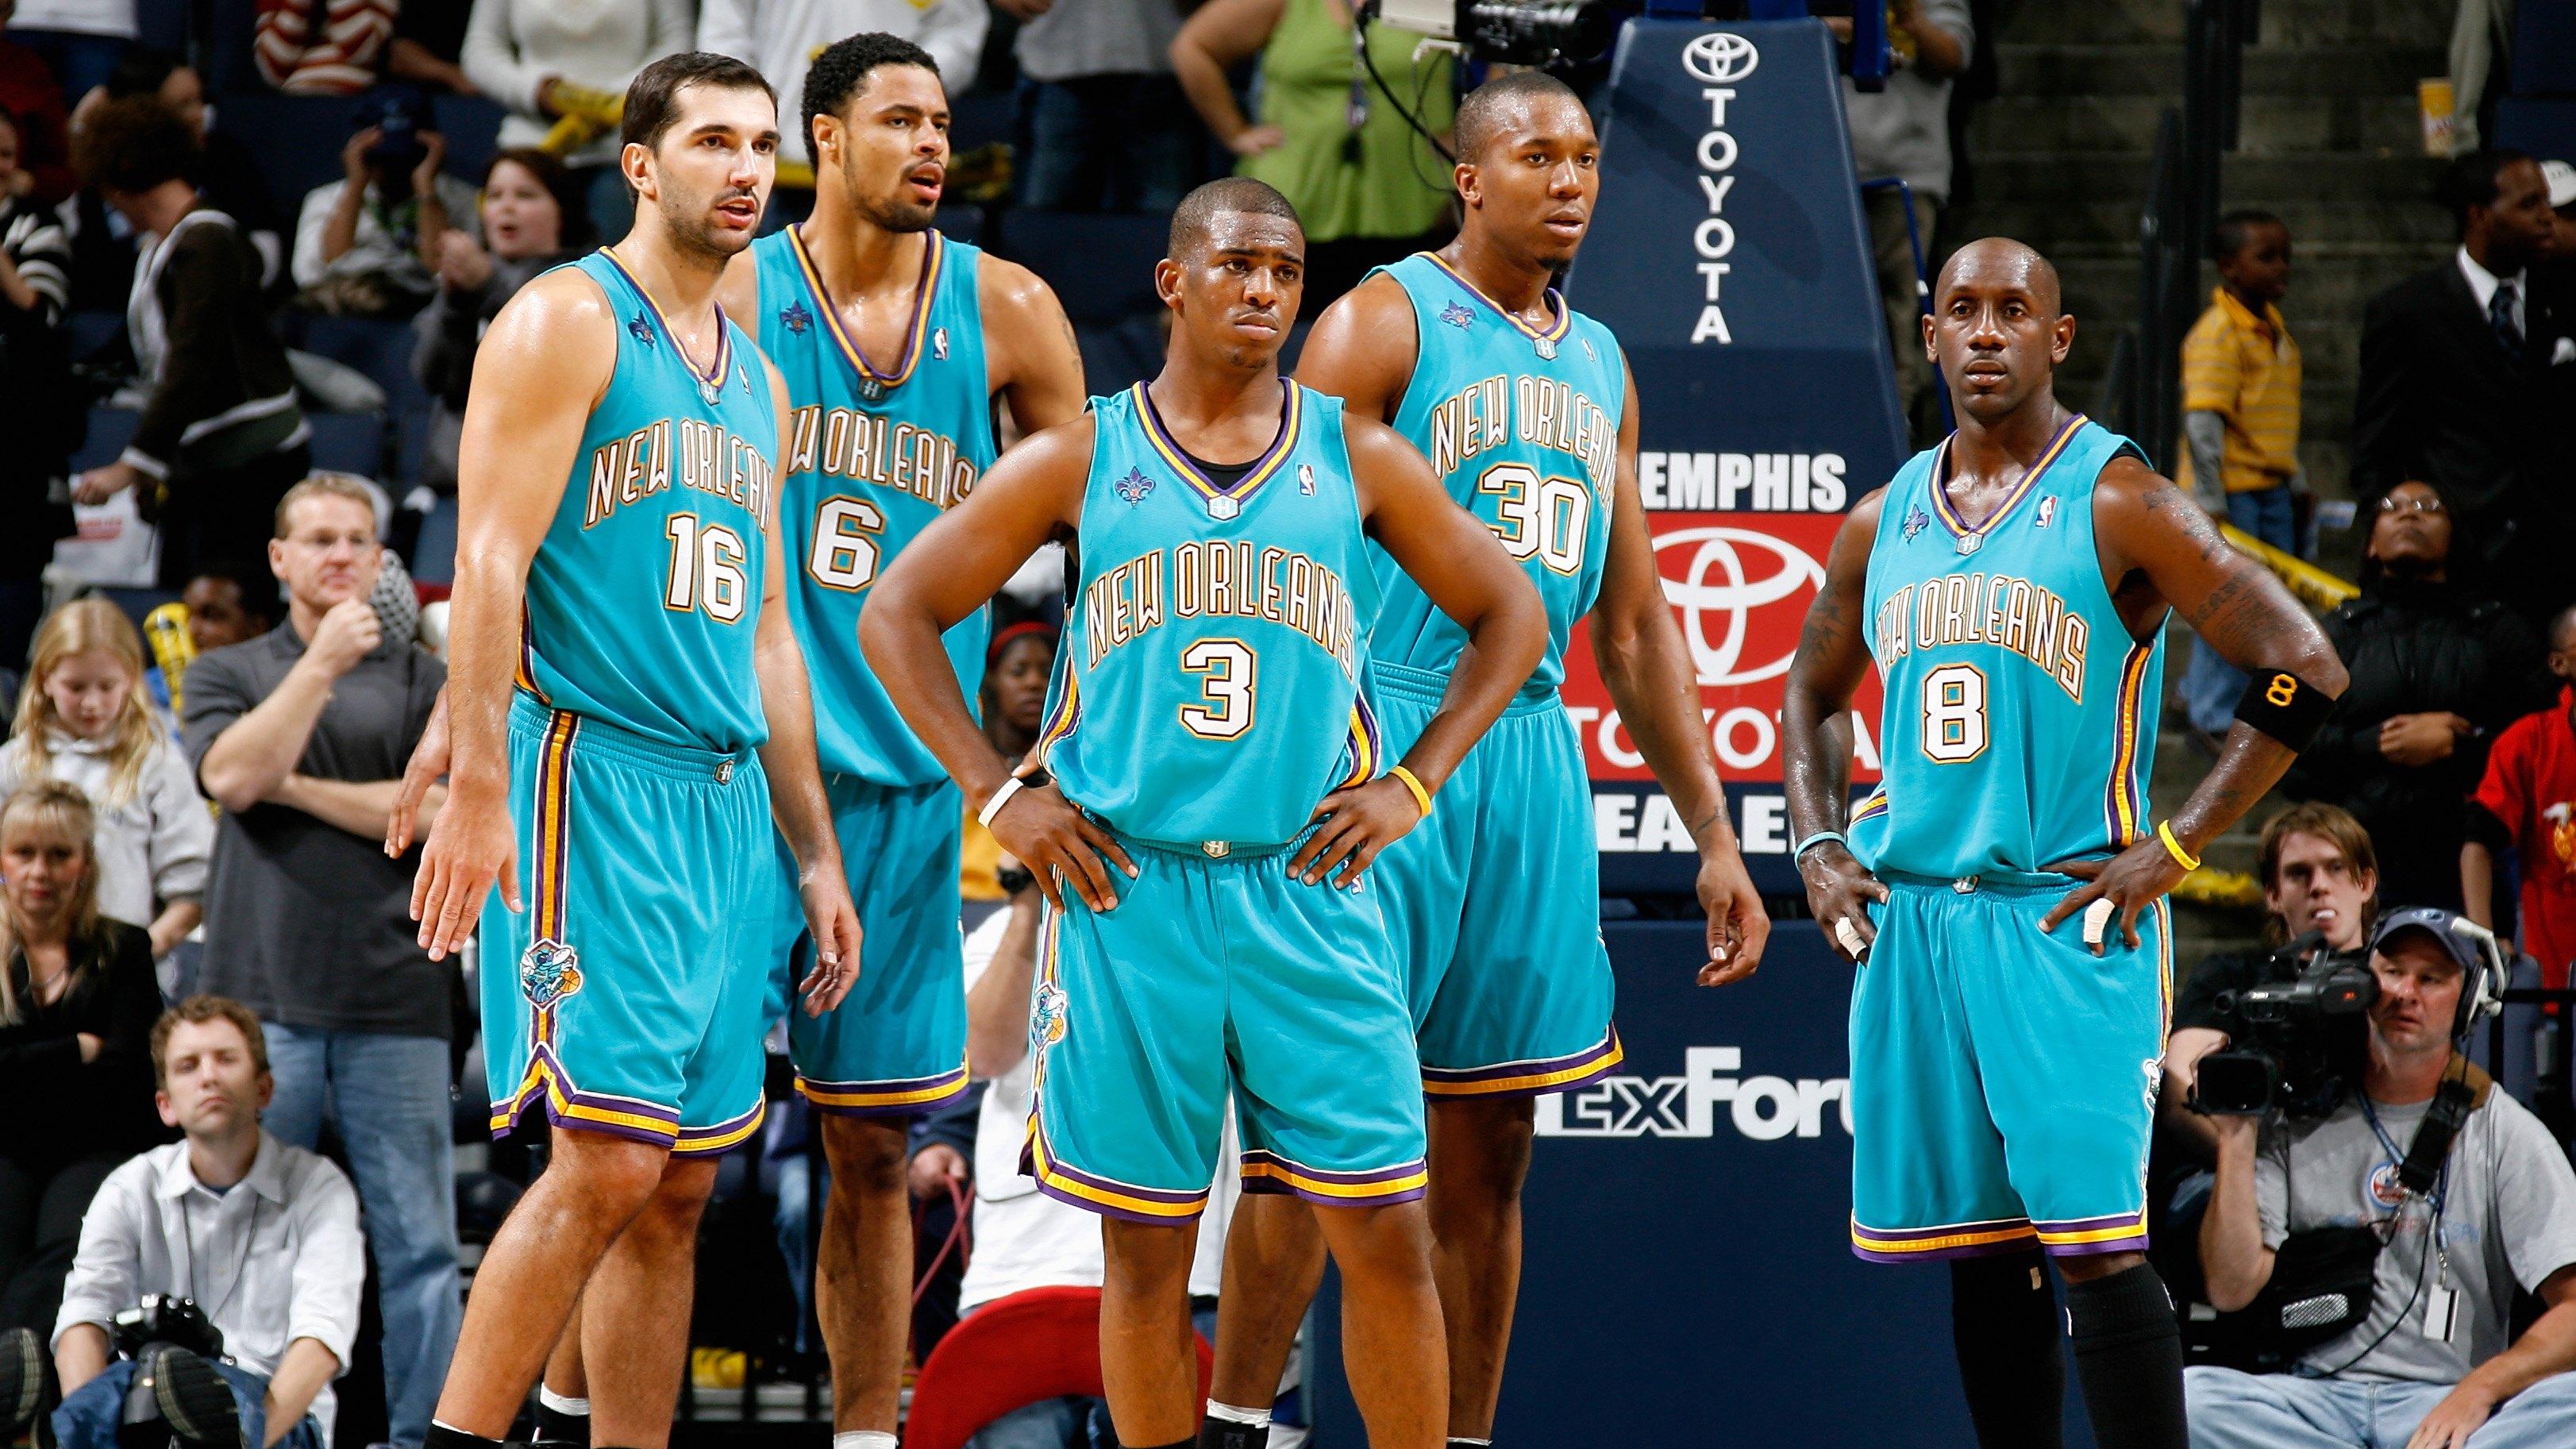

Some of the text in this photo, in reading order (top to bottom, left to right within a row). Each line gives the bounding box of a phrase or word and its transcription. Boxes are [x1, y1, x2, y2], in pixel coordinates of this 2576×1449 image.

[1690, 88, 1738, 345] TOYOTA
[582, 416, 773, 534] NEW ORLEAN
[1431, 374, 1508, 479] NEW
[1479, 461, 1591, 578] 30
[1635, 452, 1847, 513] EMPHIS
[664, 511, 745, 626] 16
[806, 494, 887, 592] 6
[1084, 540, 1354, 684] NEW ORLEANS
[1916, 571, 2089, 705] ORLEANS
[1178, 637, 1258, 742] 3
[1920, 662, 1989, 765] 8
[2266, 673, 2297, 707] 8
[1534, 1046, 1854, 1140] ExFor
